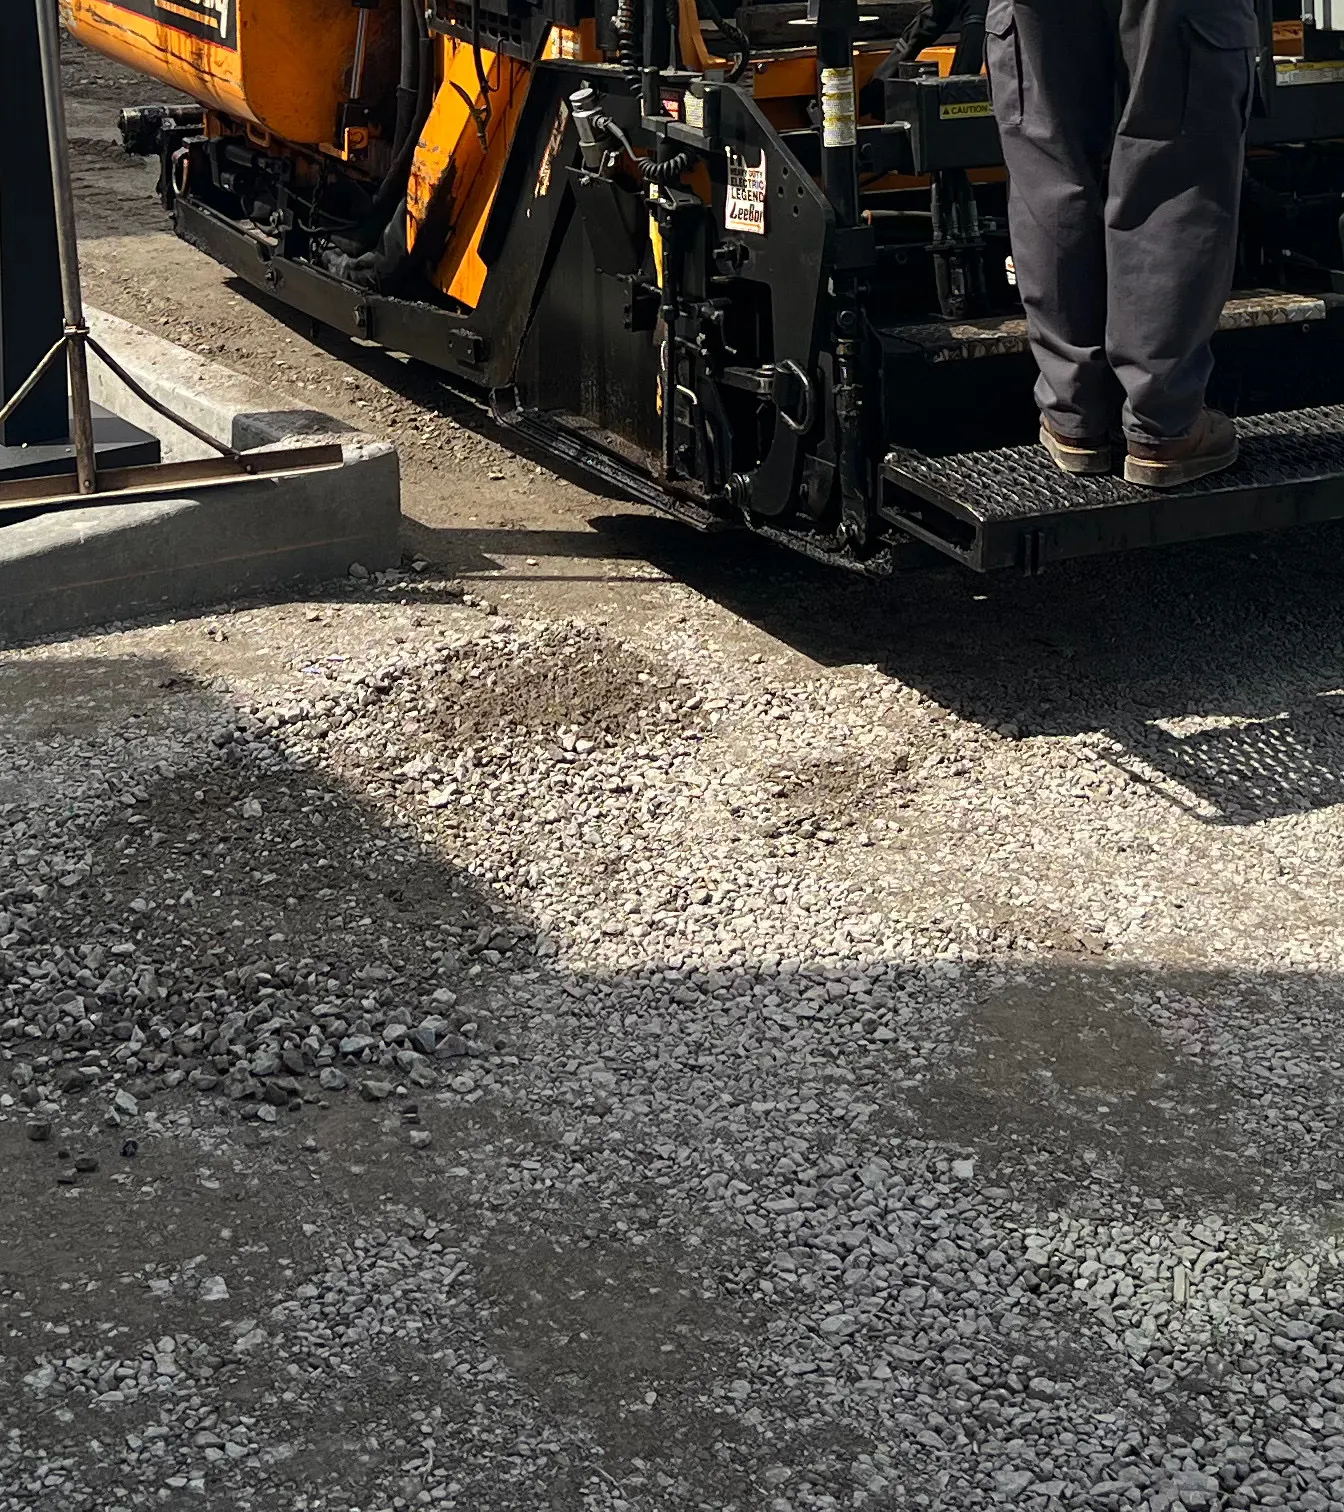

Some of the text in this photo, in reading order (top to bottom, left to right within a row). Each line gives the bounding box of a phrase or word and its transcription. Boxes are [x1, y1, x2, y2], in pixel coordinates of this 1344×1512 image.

[951, 104, 989, 115] CAUTION
[730, 176, 764, 190] ELECTRIC
[731, 187, 765, 203] LEGEND
